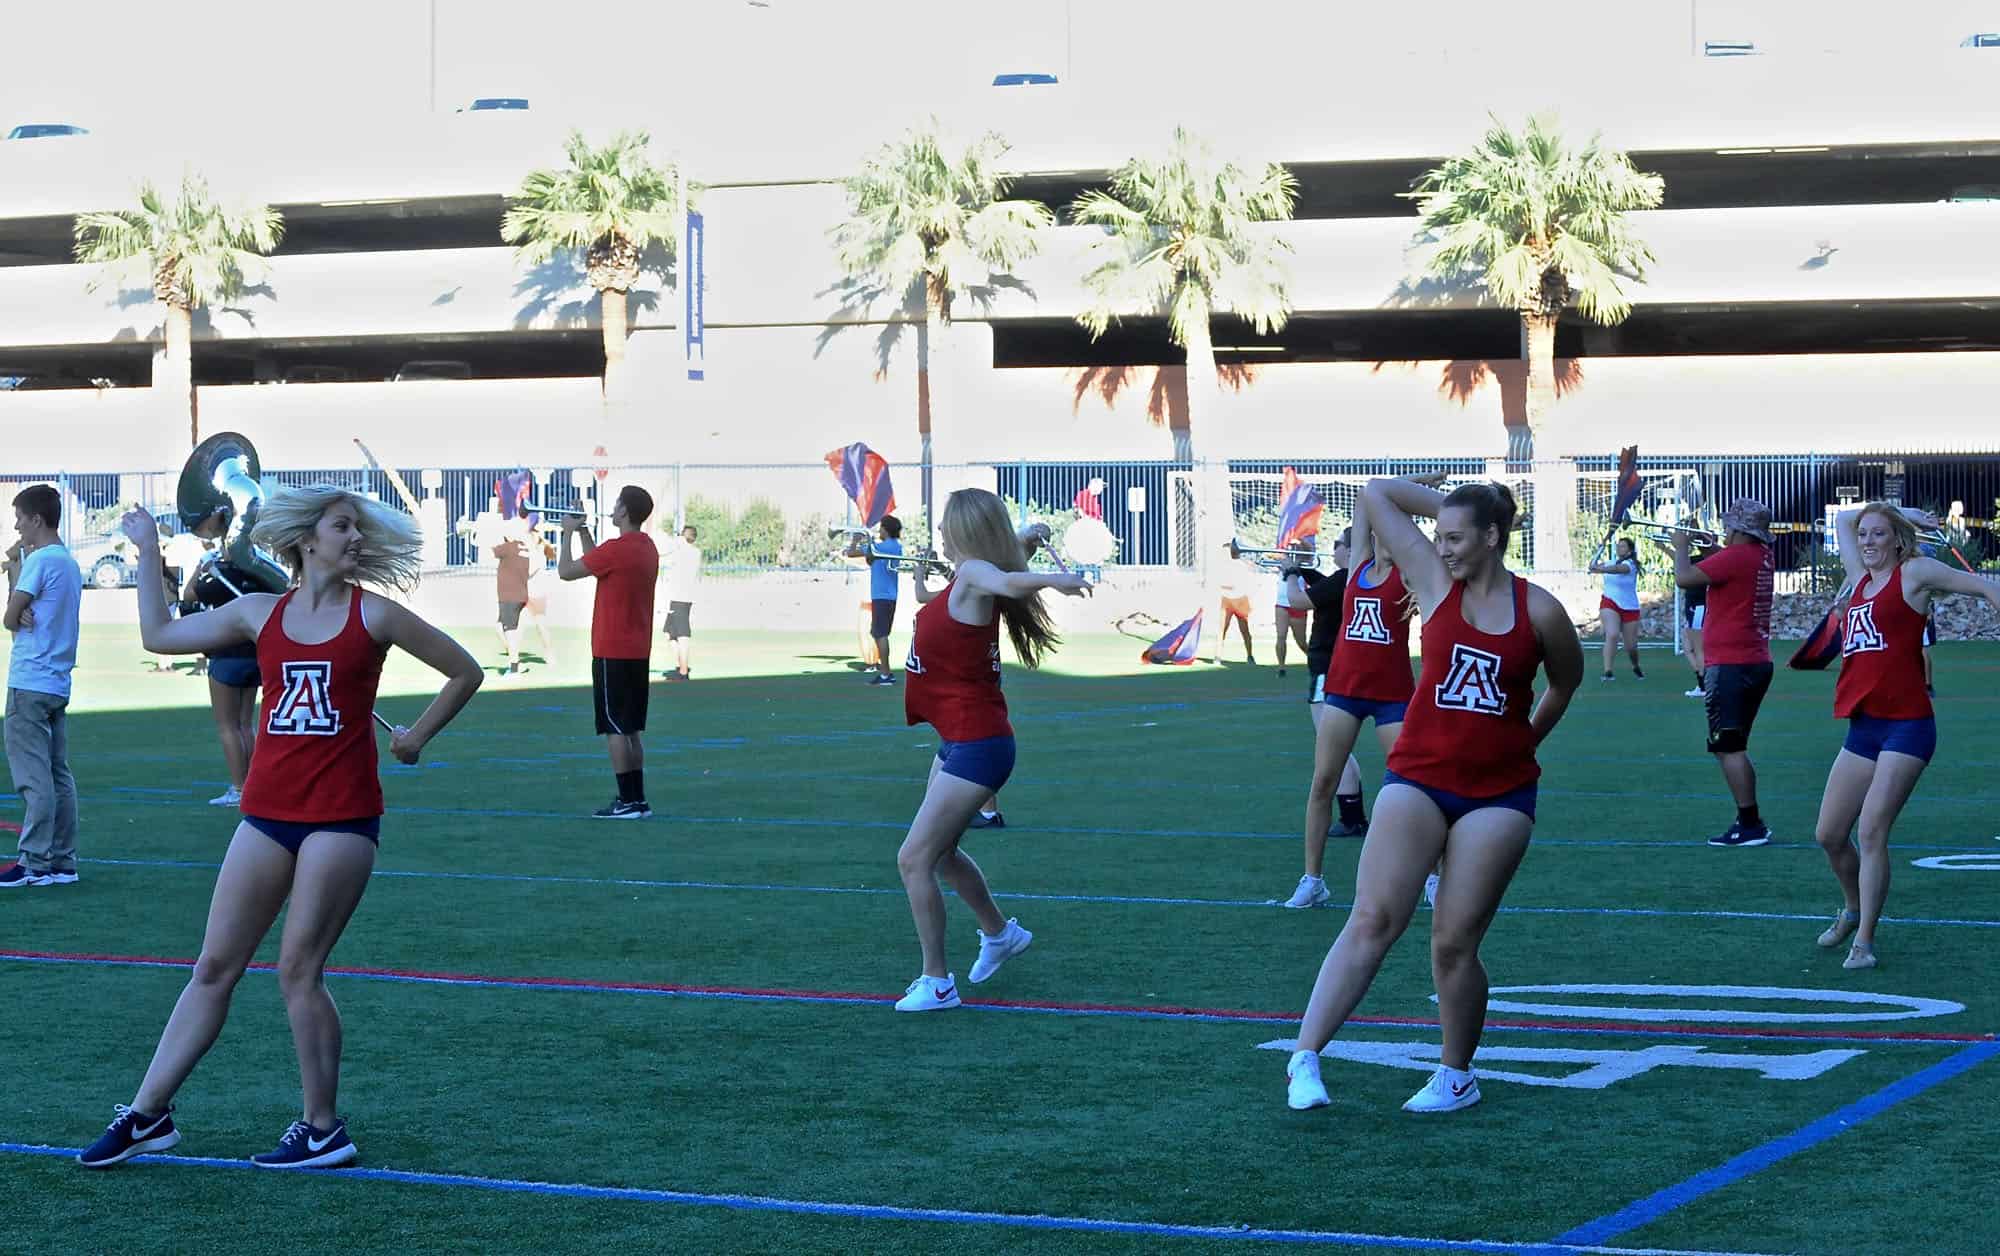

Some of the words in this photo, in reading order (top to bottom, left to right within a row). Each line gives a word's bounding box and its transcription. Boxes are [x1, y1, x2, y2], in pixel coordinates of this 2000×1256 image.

[1345, 597, 1390, 644] A
[1842, 600, 1884, 658] A
[267, 661, 339, 735] A
[1435, 643, 1506, 716] A
